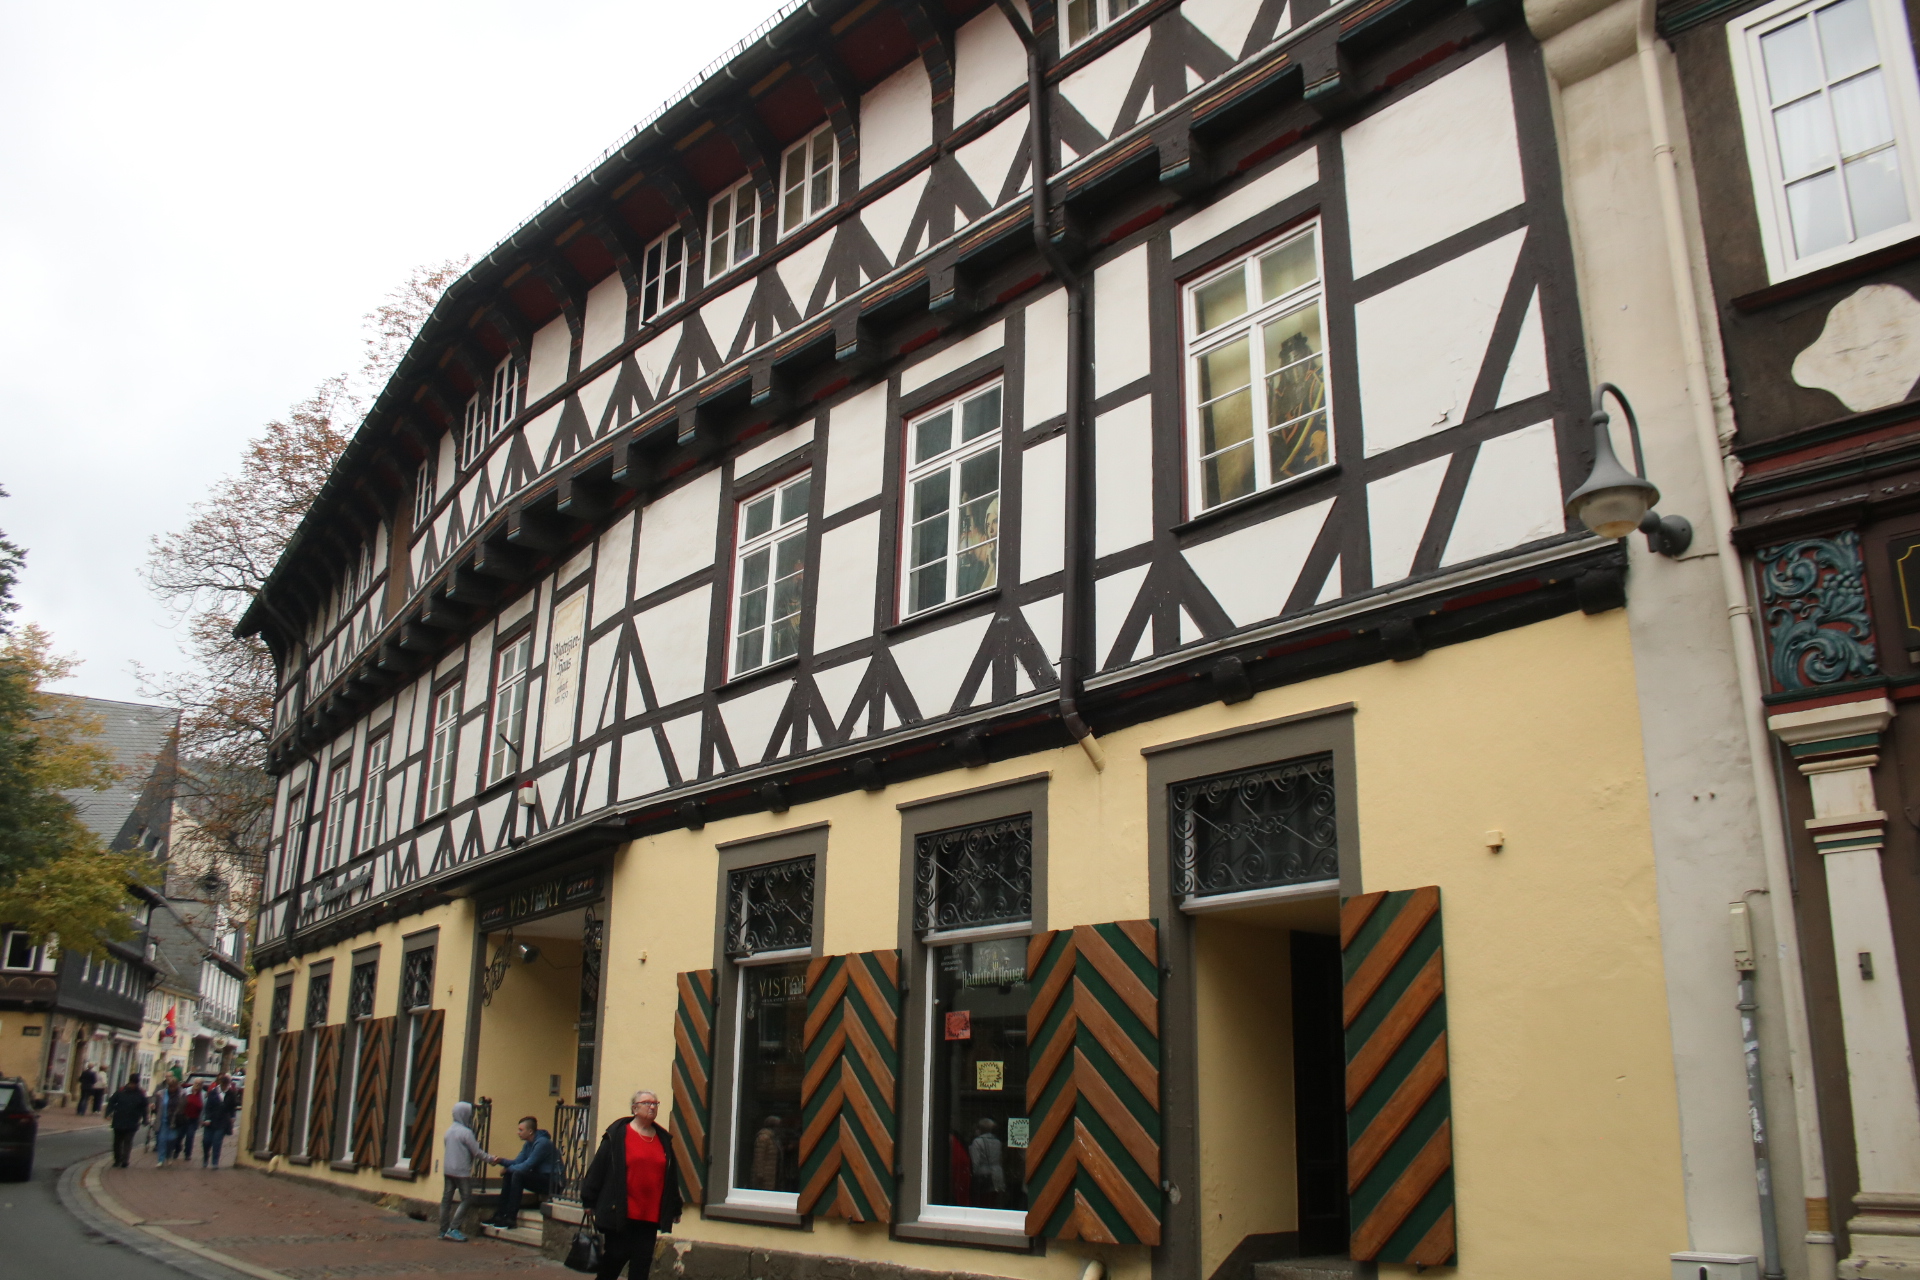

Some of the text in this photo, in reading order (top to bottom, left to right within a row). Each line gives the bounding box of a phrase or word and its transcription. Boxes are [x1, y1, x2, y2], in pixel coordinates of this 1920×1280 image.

[509, 878, 563, 918] VISTORY
[962, 965, 1025, 991] Haunted House
